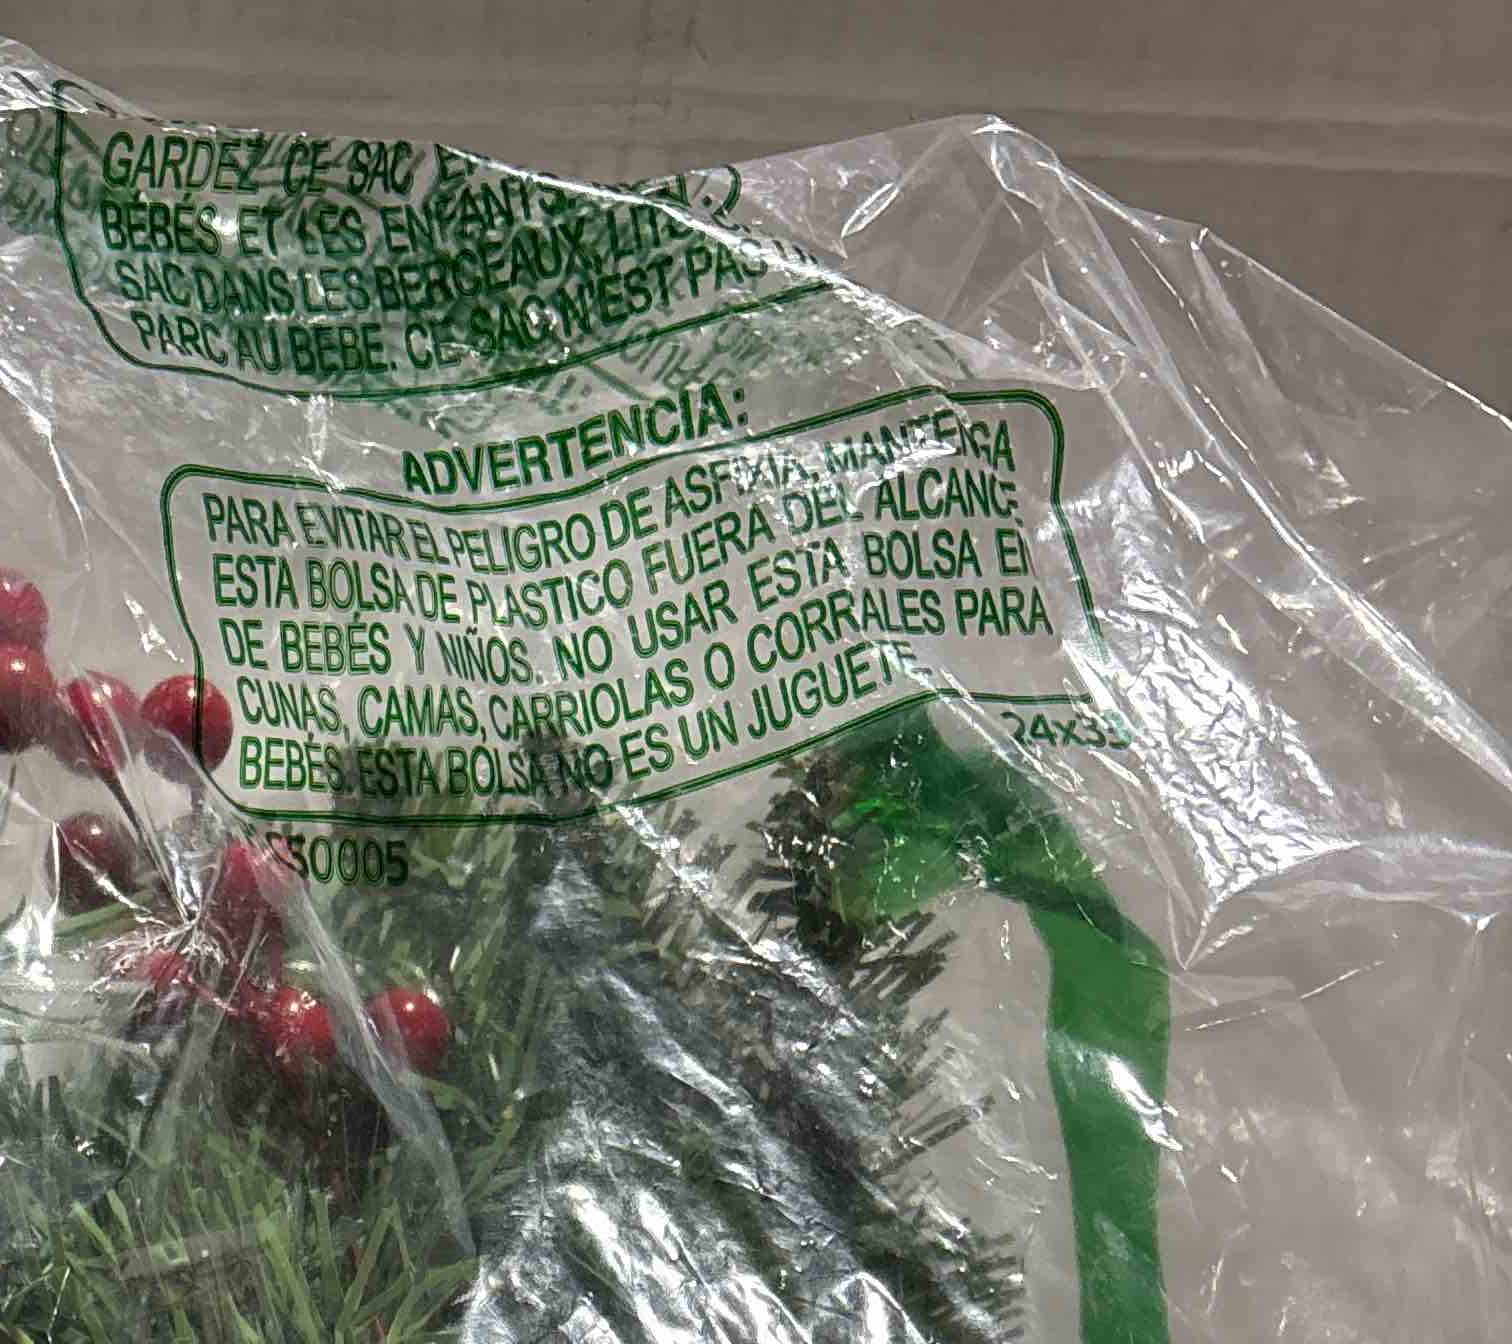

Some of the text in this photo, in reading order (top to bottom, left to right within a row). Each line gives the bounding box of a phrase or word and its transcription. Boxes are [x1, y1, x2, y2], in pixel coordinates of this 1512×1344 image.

[102, 130, 263, 193] GARDEZ
[283, 139, 330, 196] CE
[347, 139, 413, 195] SAC
[239, 204, 282, 257] ET
[296, 204, 366, 256] LES
[114, 258, 192, 308] SAC
[191, 264, 296, 315] DANS
[299, 265, 371, 313] LES
[130, 309, 229, 368] PARC
[237, 324, 283, 374] AU
[404, 316, 462, 370] CE
[401, 383, 749, 497] ADVERTENCIA:
[201, 492, 293, 547] PARA
[295, 501, 412, 562] EVITAR
[404, 518, 450, 566] EL
[445, 511, 596, 576] PELIGRO
[599, 486, 659, 551] DE
[212, 552, 300, 609] ESTA
[305, 557, 413, 614] BOLSA
[413, 572, 461, 624] DE
[465, 556, 634, 630] PLASTICO
[640, 503, 776, 595] FUERA
[782, 481, 865, 537] DEL
[218, 617, 269, 671] DE
[279, 611, 392, 676] BEBÉS
[402, 620, 426, 676] Y
[435, 626, 544, 687] NIÑOS.
[551, 624, 614, 682] NO
[626, 578, 739, 658] USAR
[747, 537, 851, 612] ESTA
[862, 526, 982, 580] BOLSA
[235, 586, 1055, 743] CUNAS, CAMAS, CARRIOLAS O CORRALES PARA
[357, 745, 441, 799] ESTA
[445, 743, 548, 798] BOLSA
[558, 741, 615, 791] NO
[621, 721, 677, 781] ES
[678, 700, 740, 761] UN
